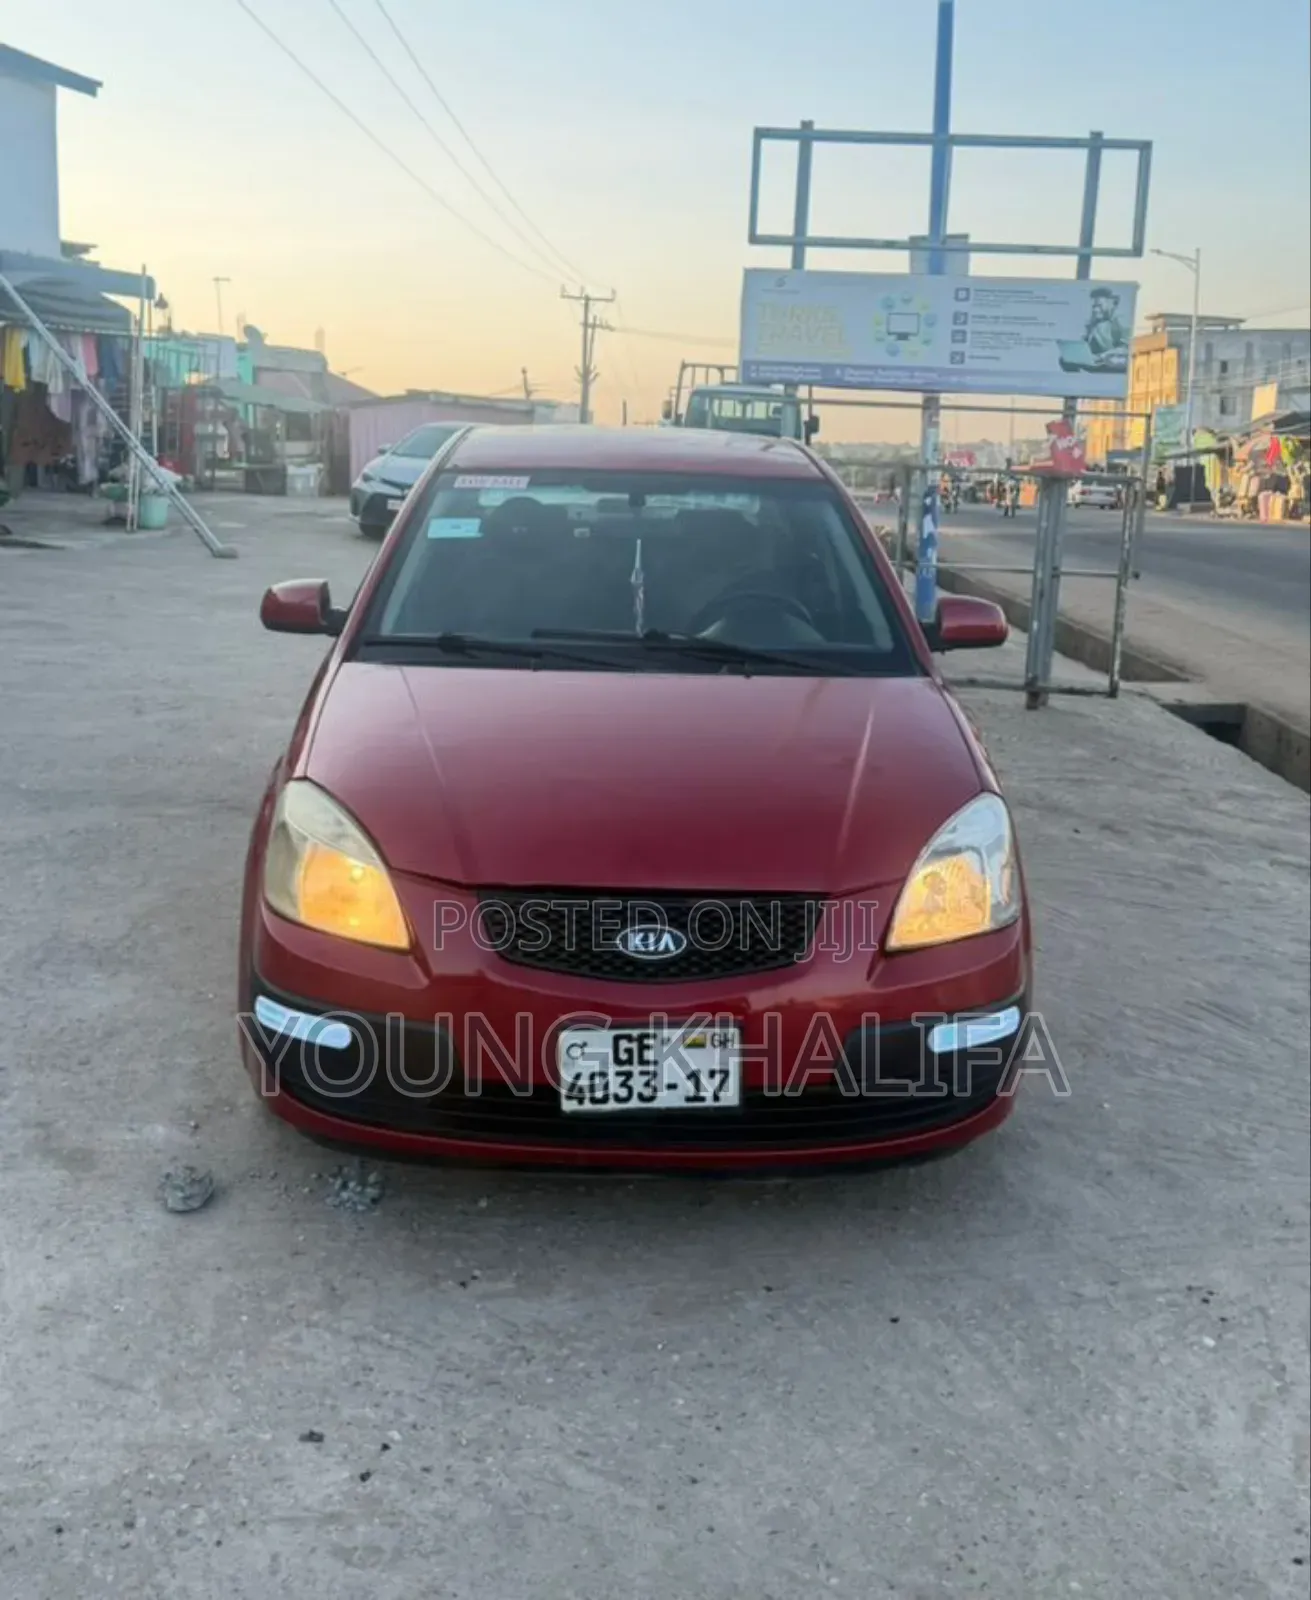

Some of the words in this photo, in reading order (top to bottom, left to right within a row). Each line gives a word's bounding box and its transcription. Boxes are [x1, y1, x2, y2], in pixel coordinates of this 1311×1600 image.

[628, 932, 676, 951] KIA
[612, 1033, 659, 1067] GE
[711, 1032, 735, 1049] GH
[565, 1068, 730, 1105] 4033-17
